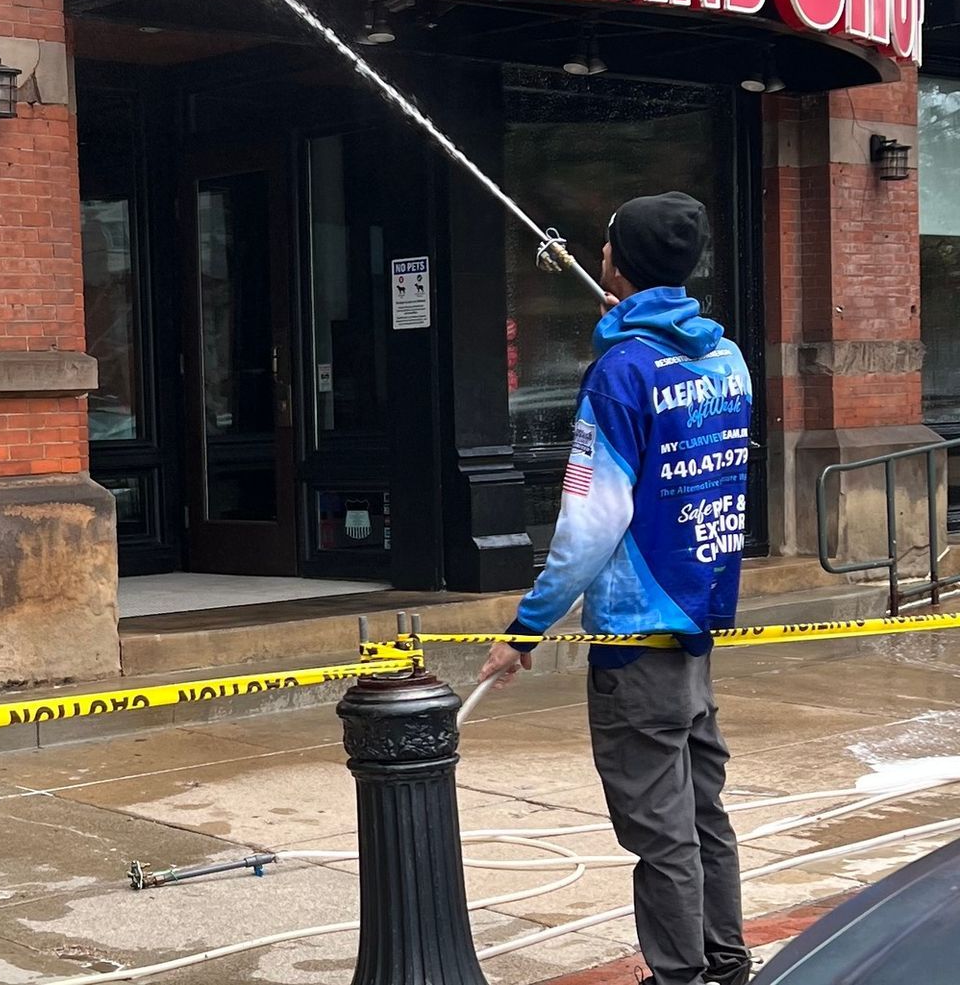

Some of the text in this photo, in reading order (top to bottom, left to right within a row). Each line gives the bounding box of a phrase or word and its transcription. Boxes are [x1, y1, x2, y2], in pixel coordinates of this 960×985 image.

[395, 261, 425, 273] NO PETS
[678, 498, 713, 525] Safe
[736, 494, 746, 512] &
